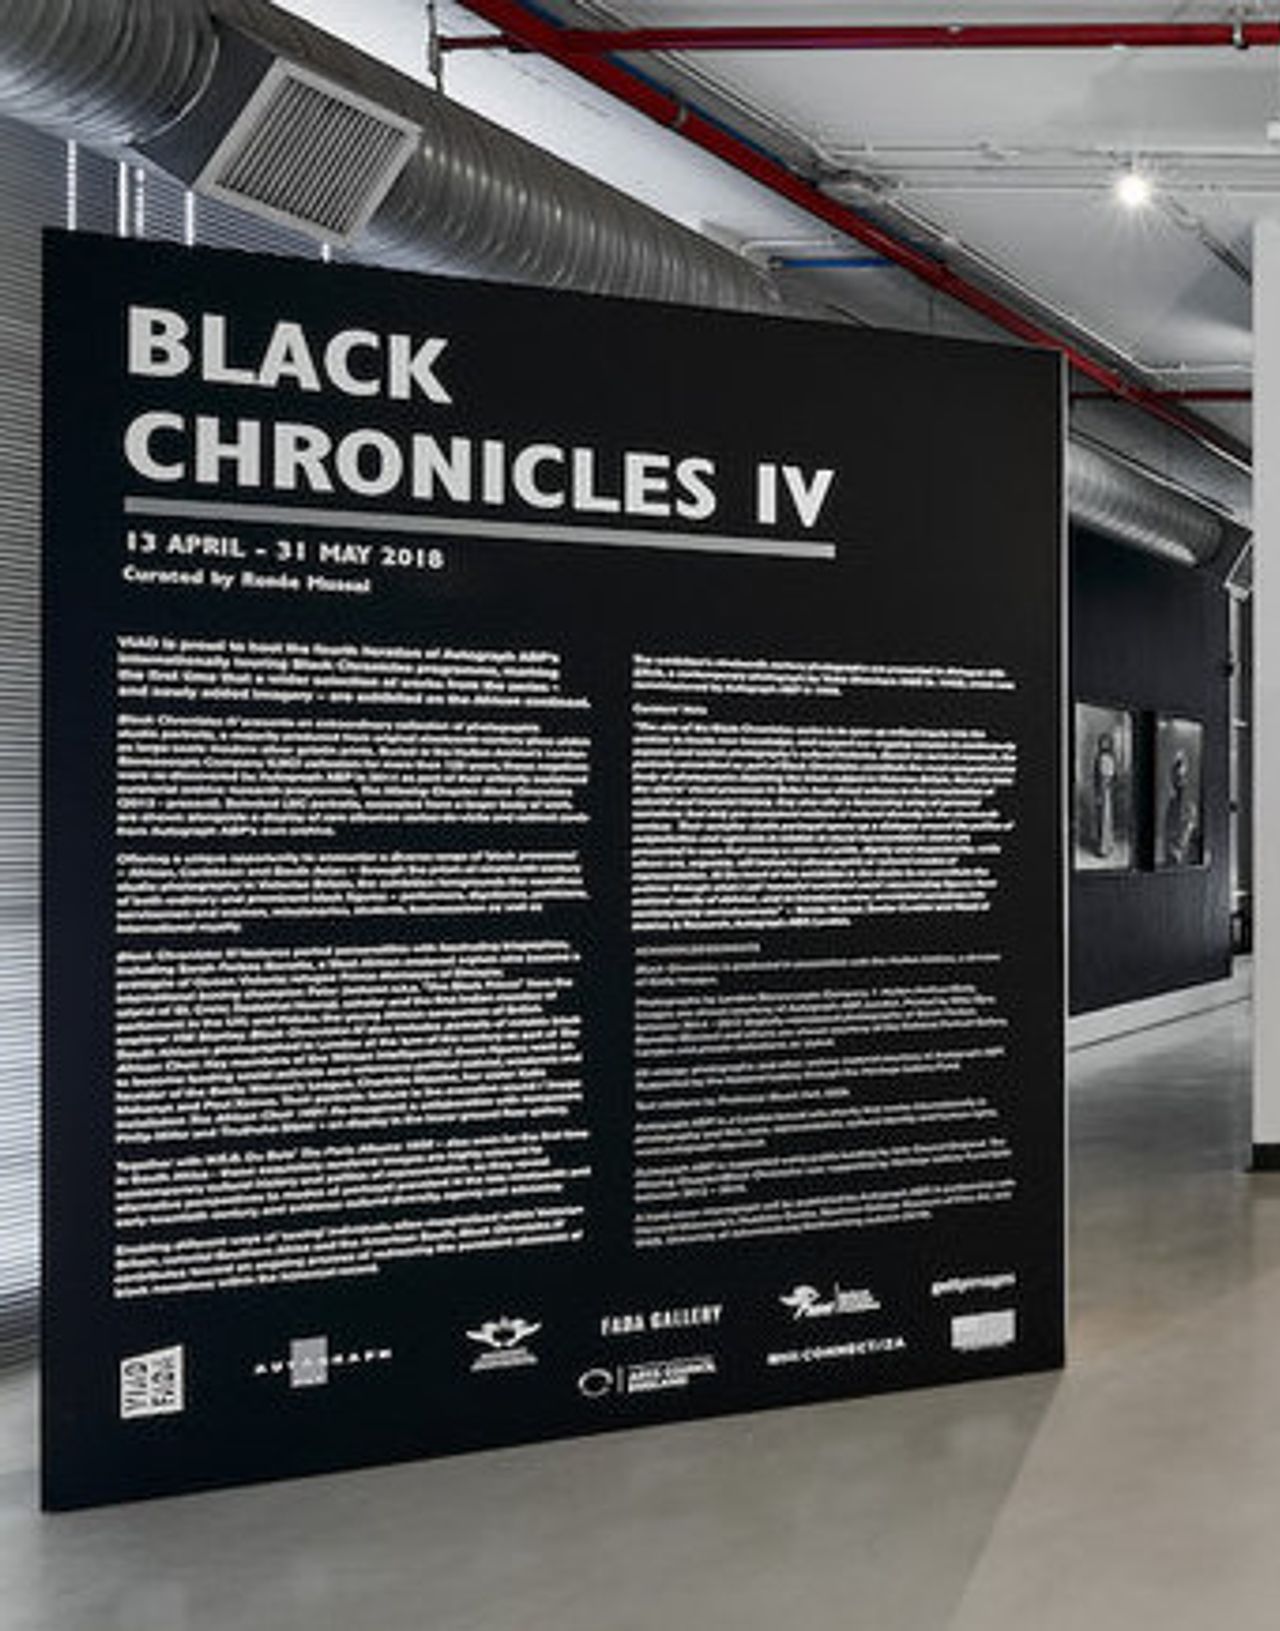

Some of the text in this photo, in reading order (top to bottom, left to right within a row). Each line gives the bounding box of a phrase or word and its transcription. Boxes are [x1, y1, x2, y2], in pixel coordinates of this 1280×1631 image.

[127, 306, 452, 404] BLACK
[123, 411, 835, 529] CHRONICLES IV
[122, 564, 204, 585] Curated
[210, 571, 235, 590] by
[126, 530, 156, 552] 13
[166, 534, 246, 558] APRIL
[276, 541, 306, 562] 31
[319, 542, 373, 565] MAY
[381, 546, 445, 570] 2018
